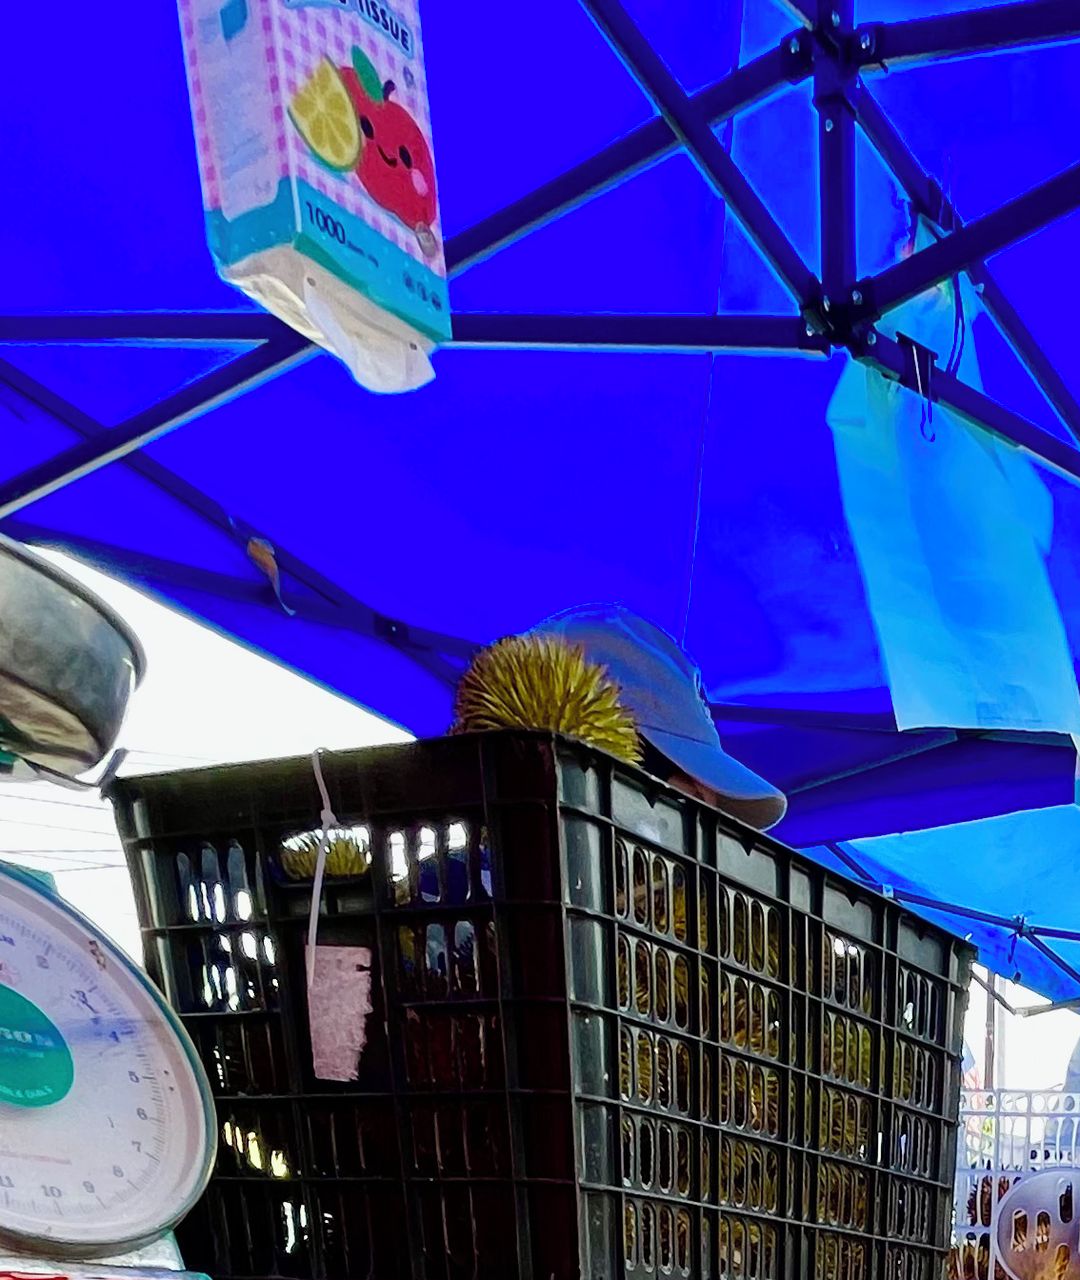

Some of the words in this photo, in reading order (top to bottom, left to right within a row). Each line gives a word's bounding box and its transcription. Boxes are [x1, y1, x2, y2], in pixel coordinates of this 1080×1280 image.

[305, 201, 346, 245] 1000
[128, 1070, 140, 1084] 5
[136, 1107, 149, 1121] 6
[131, 1140, 142, 1153] 7
[112, 1165, 125, 1178] 8
[41, 1184, 63, 1199] 10
[82, 1180, 95, 1194] 9
